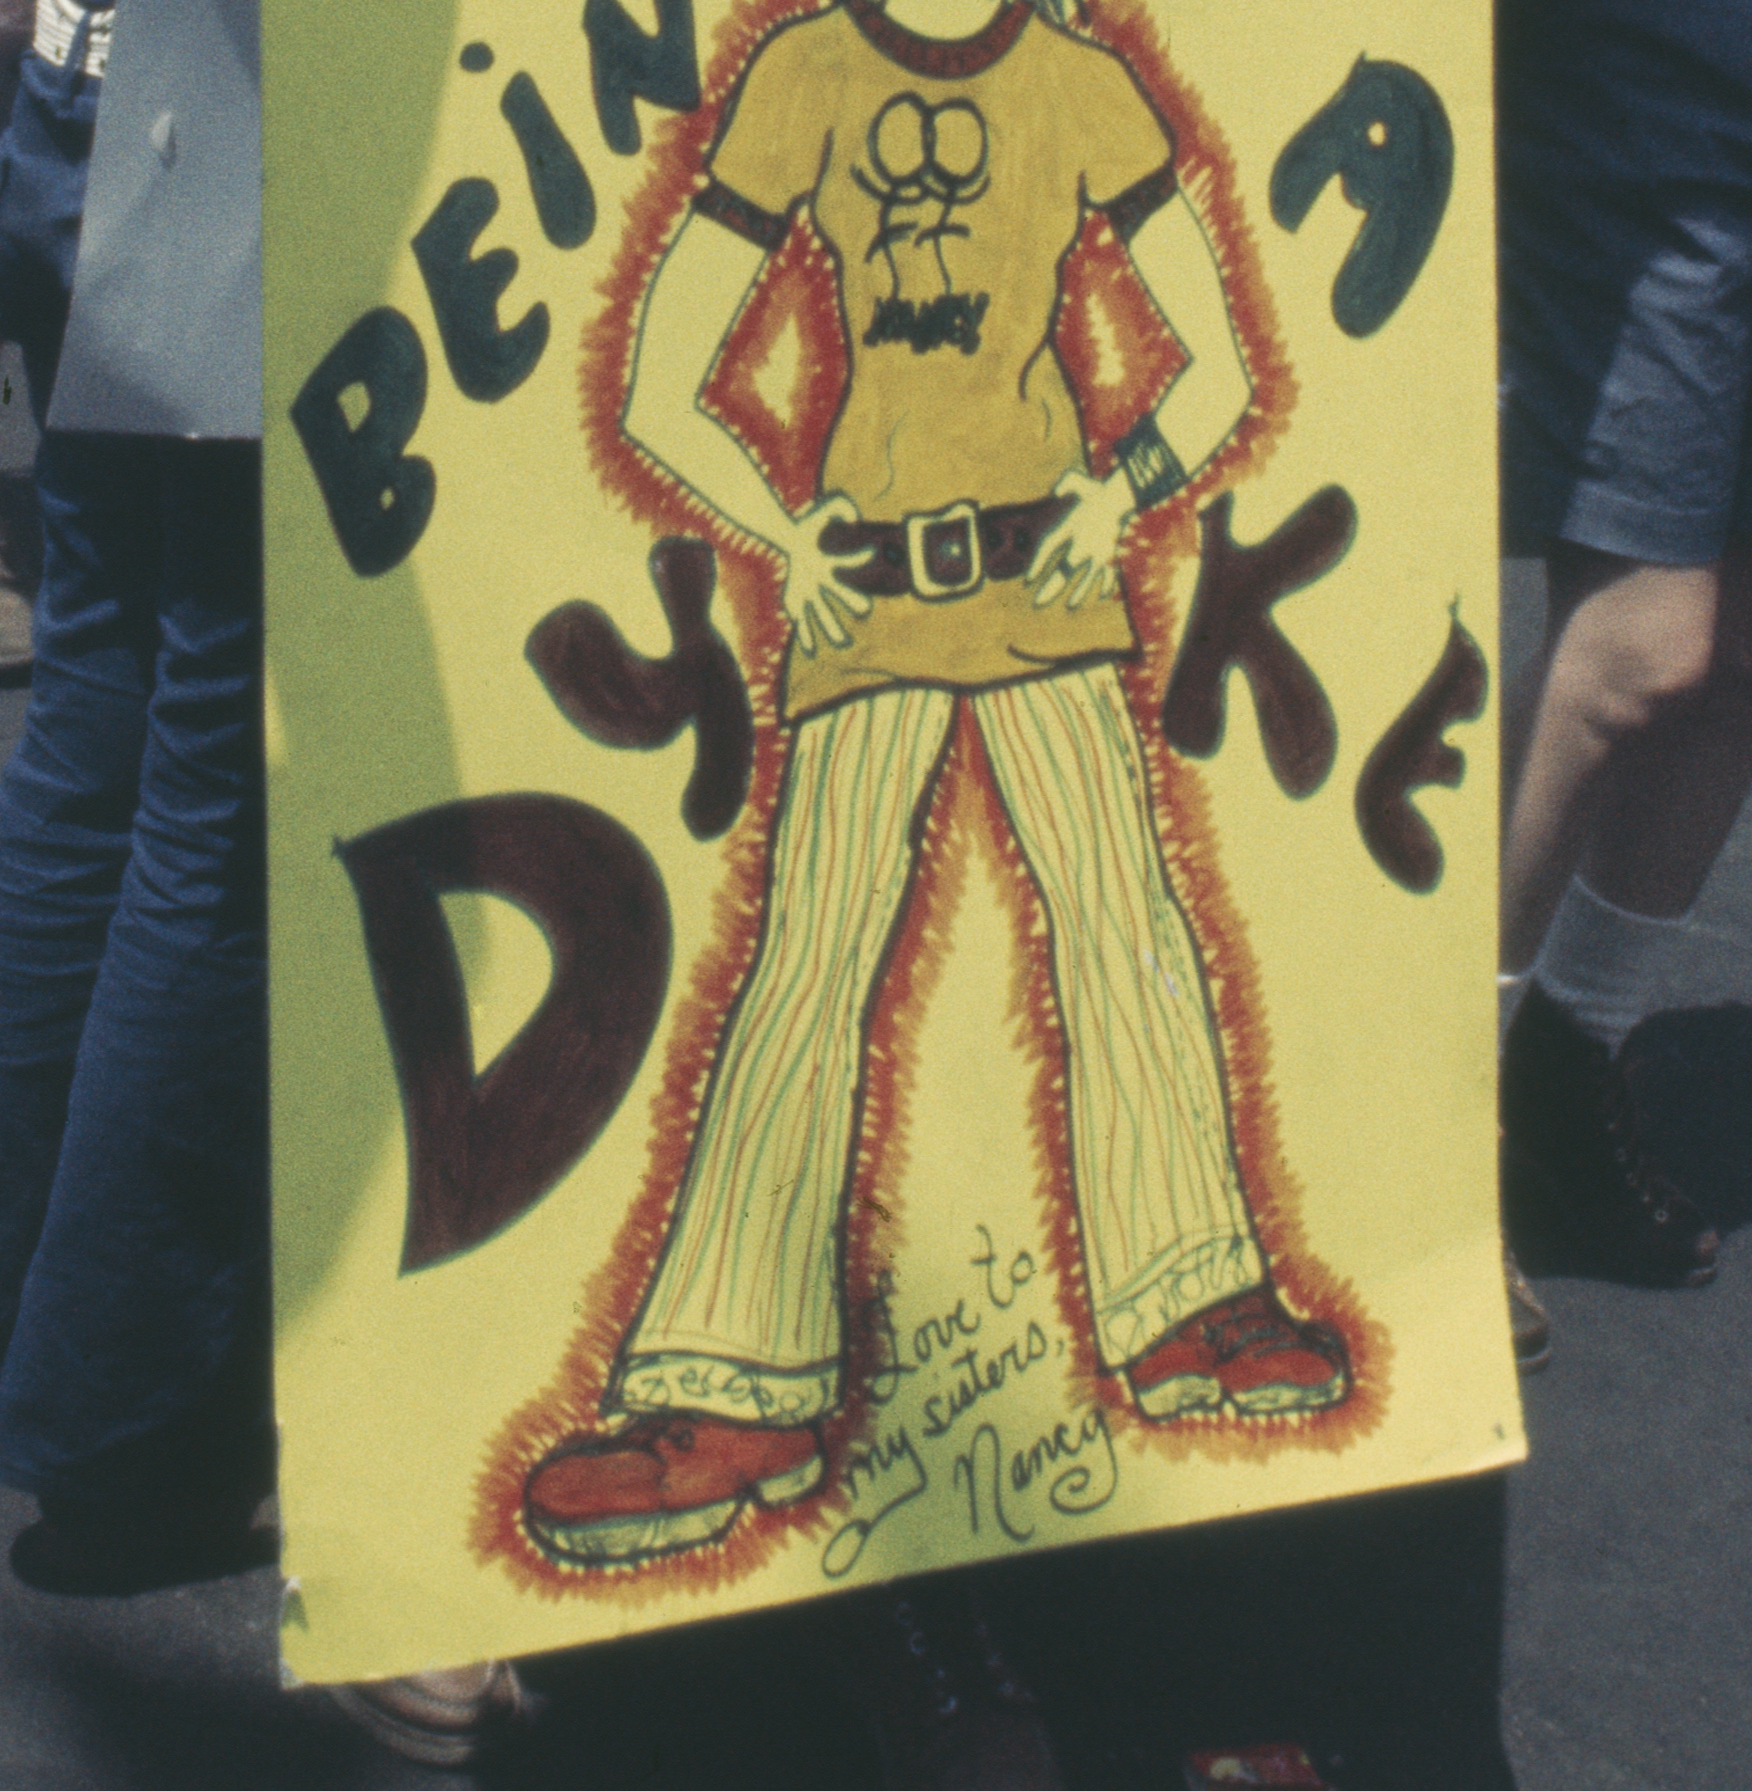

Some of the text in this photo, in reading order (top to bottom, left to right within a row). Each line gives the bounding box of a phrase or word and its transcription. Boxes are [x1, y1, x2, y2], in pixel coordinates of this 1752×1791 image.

[1268, 49, 1455, 340] A
[331, 483, 1490, 1280] DYKE
[869, 1222, 1034, 1406] Love to
[821, 1424, 929, 1579] my
[953, 1406, 1118, 1544] Nancy
